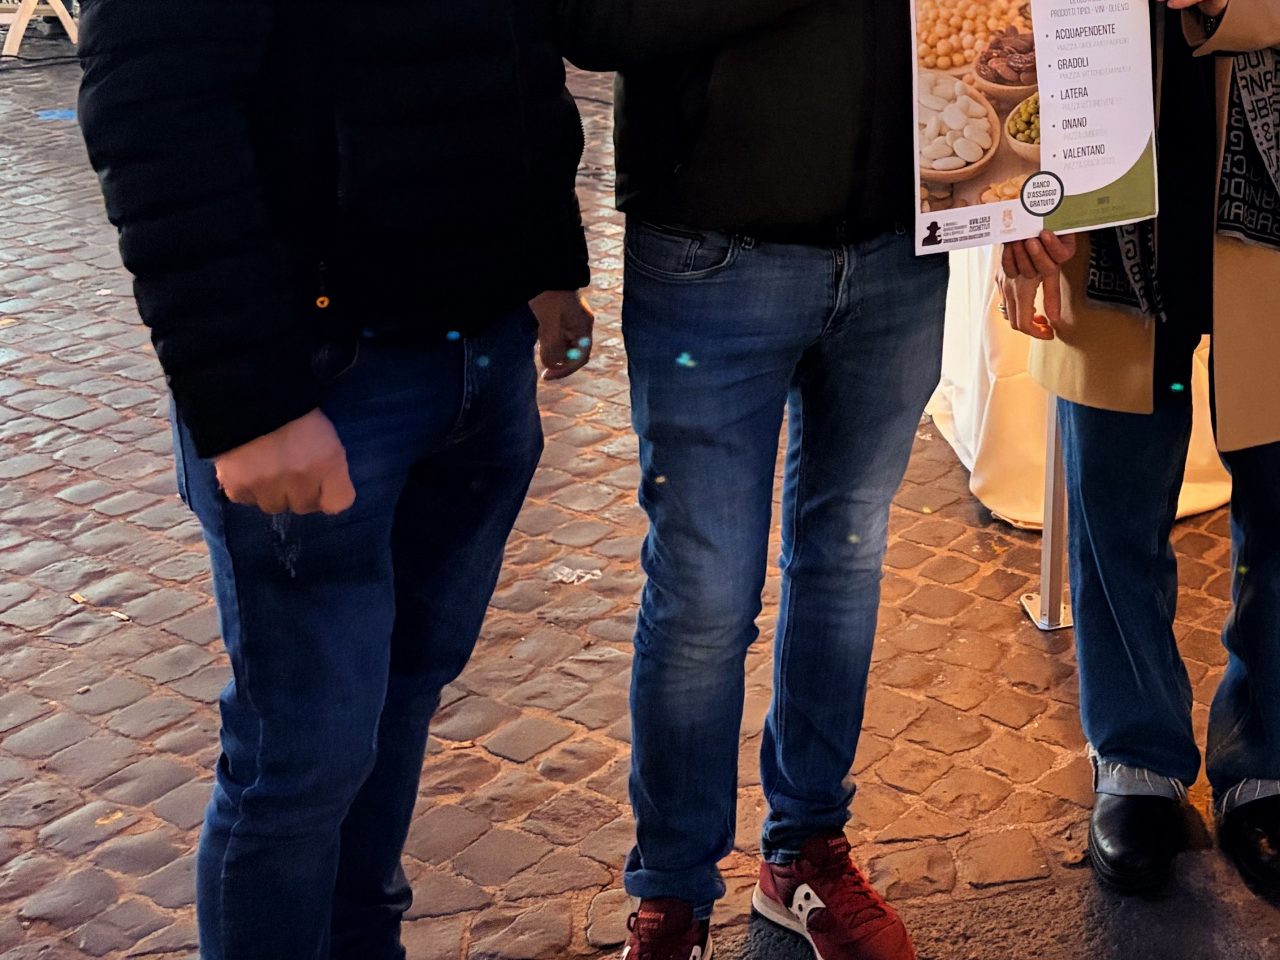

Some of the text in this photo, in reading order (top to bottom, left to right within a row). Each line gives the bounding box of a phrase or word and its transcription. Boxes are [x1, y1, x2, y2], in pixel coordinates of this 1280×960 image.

[1055, 23, 1116, 40] ACQUAPENDENTE
[1058, 57, 1089, 70] GRADOLI
[1060, 86, 1088, 101] LATERA
[1062, 116, 1087, 130] ONANO
[1063, 144, 1105, 160] VALENTANO
[1032, 180, 1051, 189] BANCO
[1027, 188, 1057, 199] D'ASSAGGIO
[1029, 198, 1055, 208] GRATUITO
